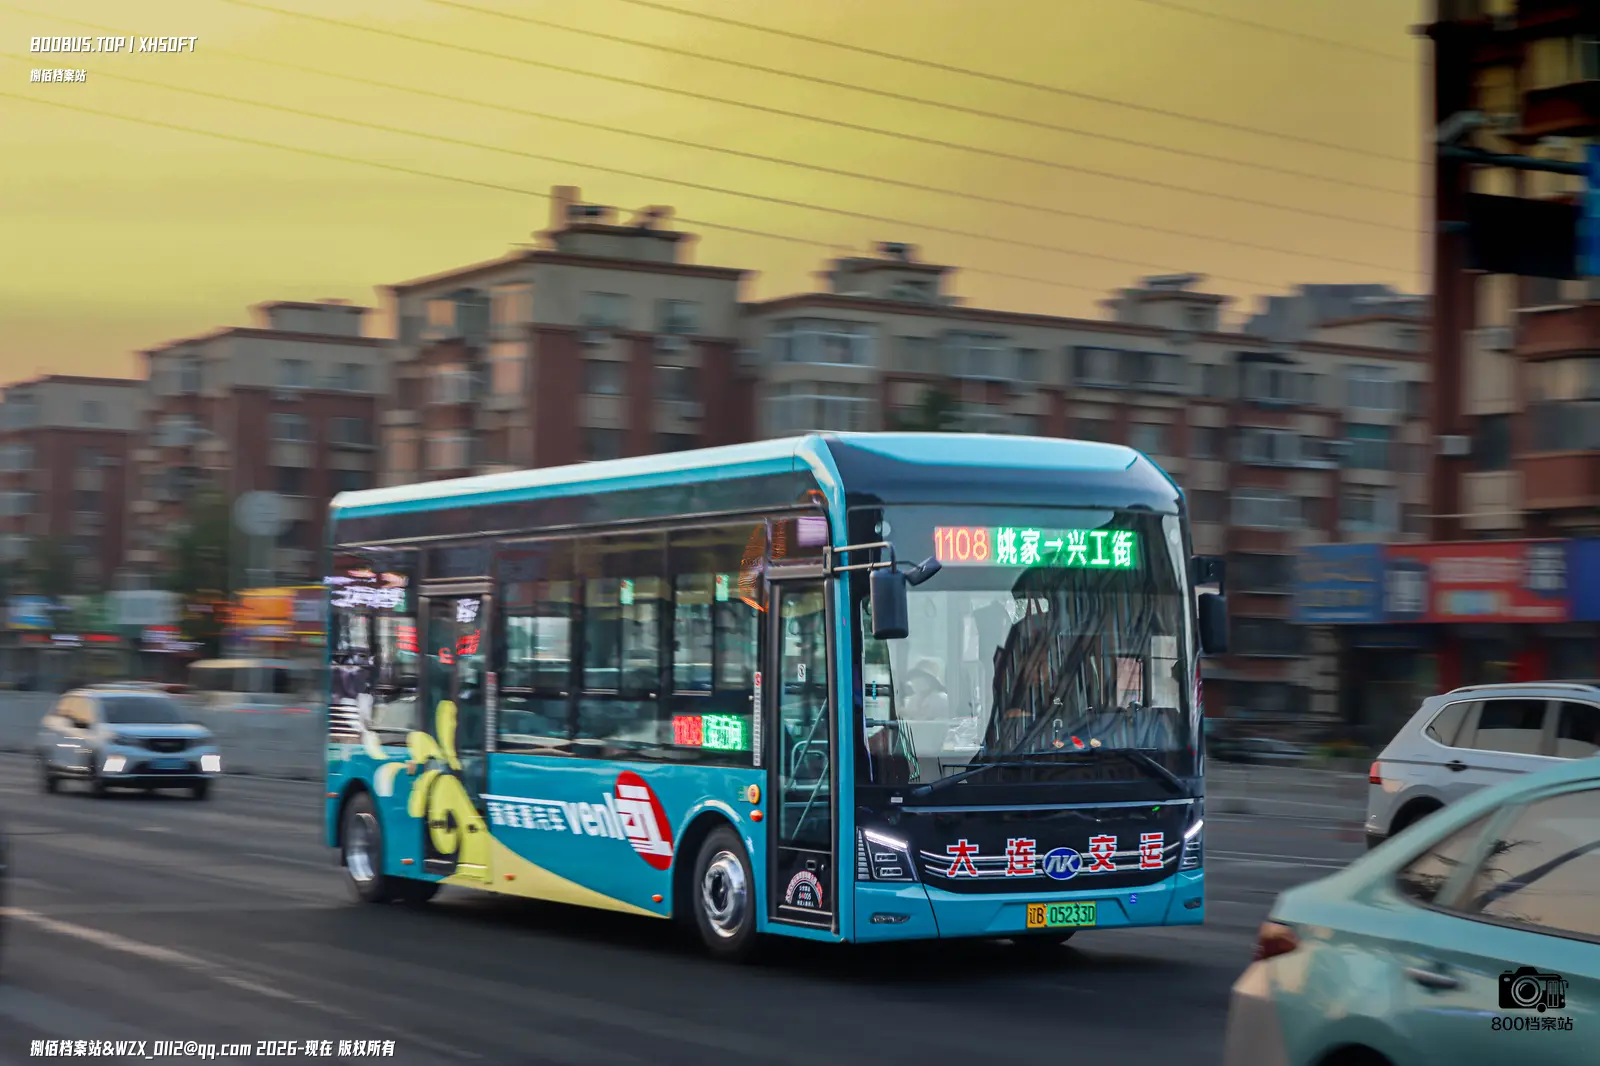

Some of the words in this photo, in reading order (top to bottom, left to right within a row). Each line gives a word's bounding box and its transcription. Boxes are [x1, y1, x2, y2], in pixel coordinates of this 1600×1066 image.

[935, 527, 988, 561] 1108
[997, 527, 1040, 564] 姚家
[1067, 529, 1133, 566] 兴工街
[946, 832, 1164, 877] 大连交运
[1029, 907, 1045, 925] 辽B
[1049, 905, 1095, 923] 05233D
